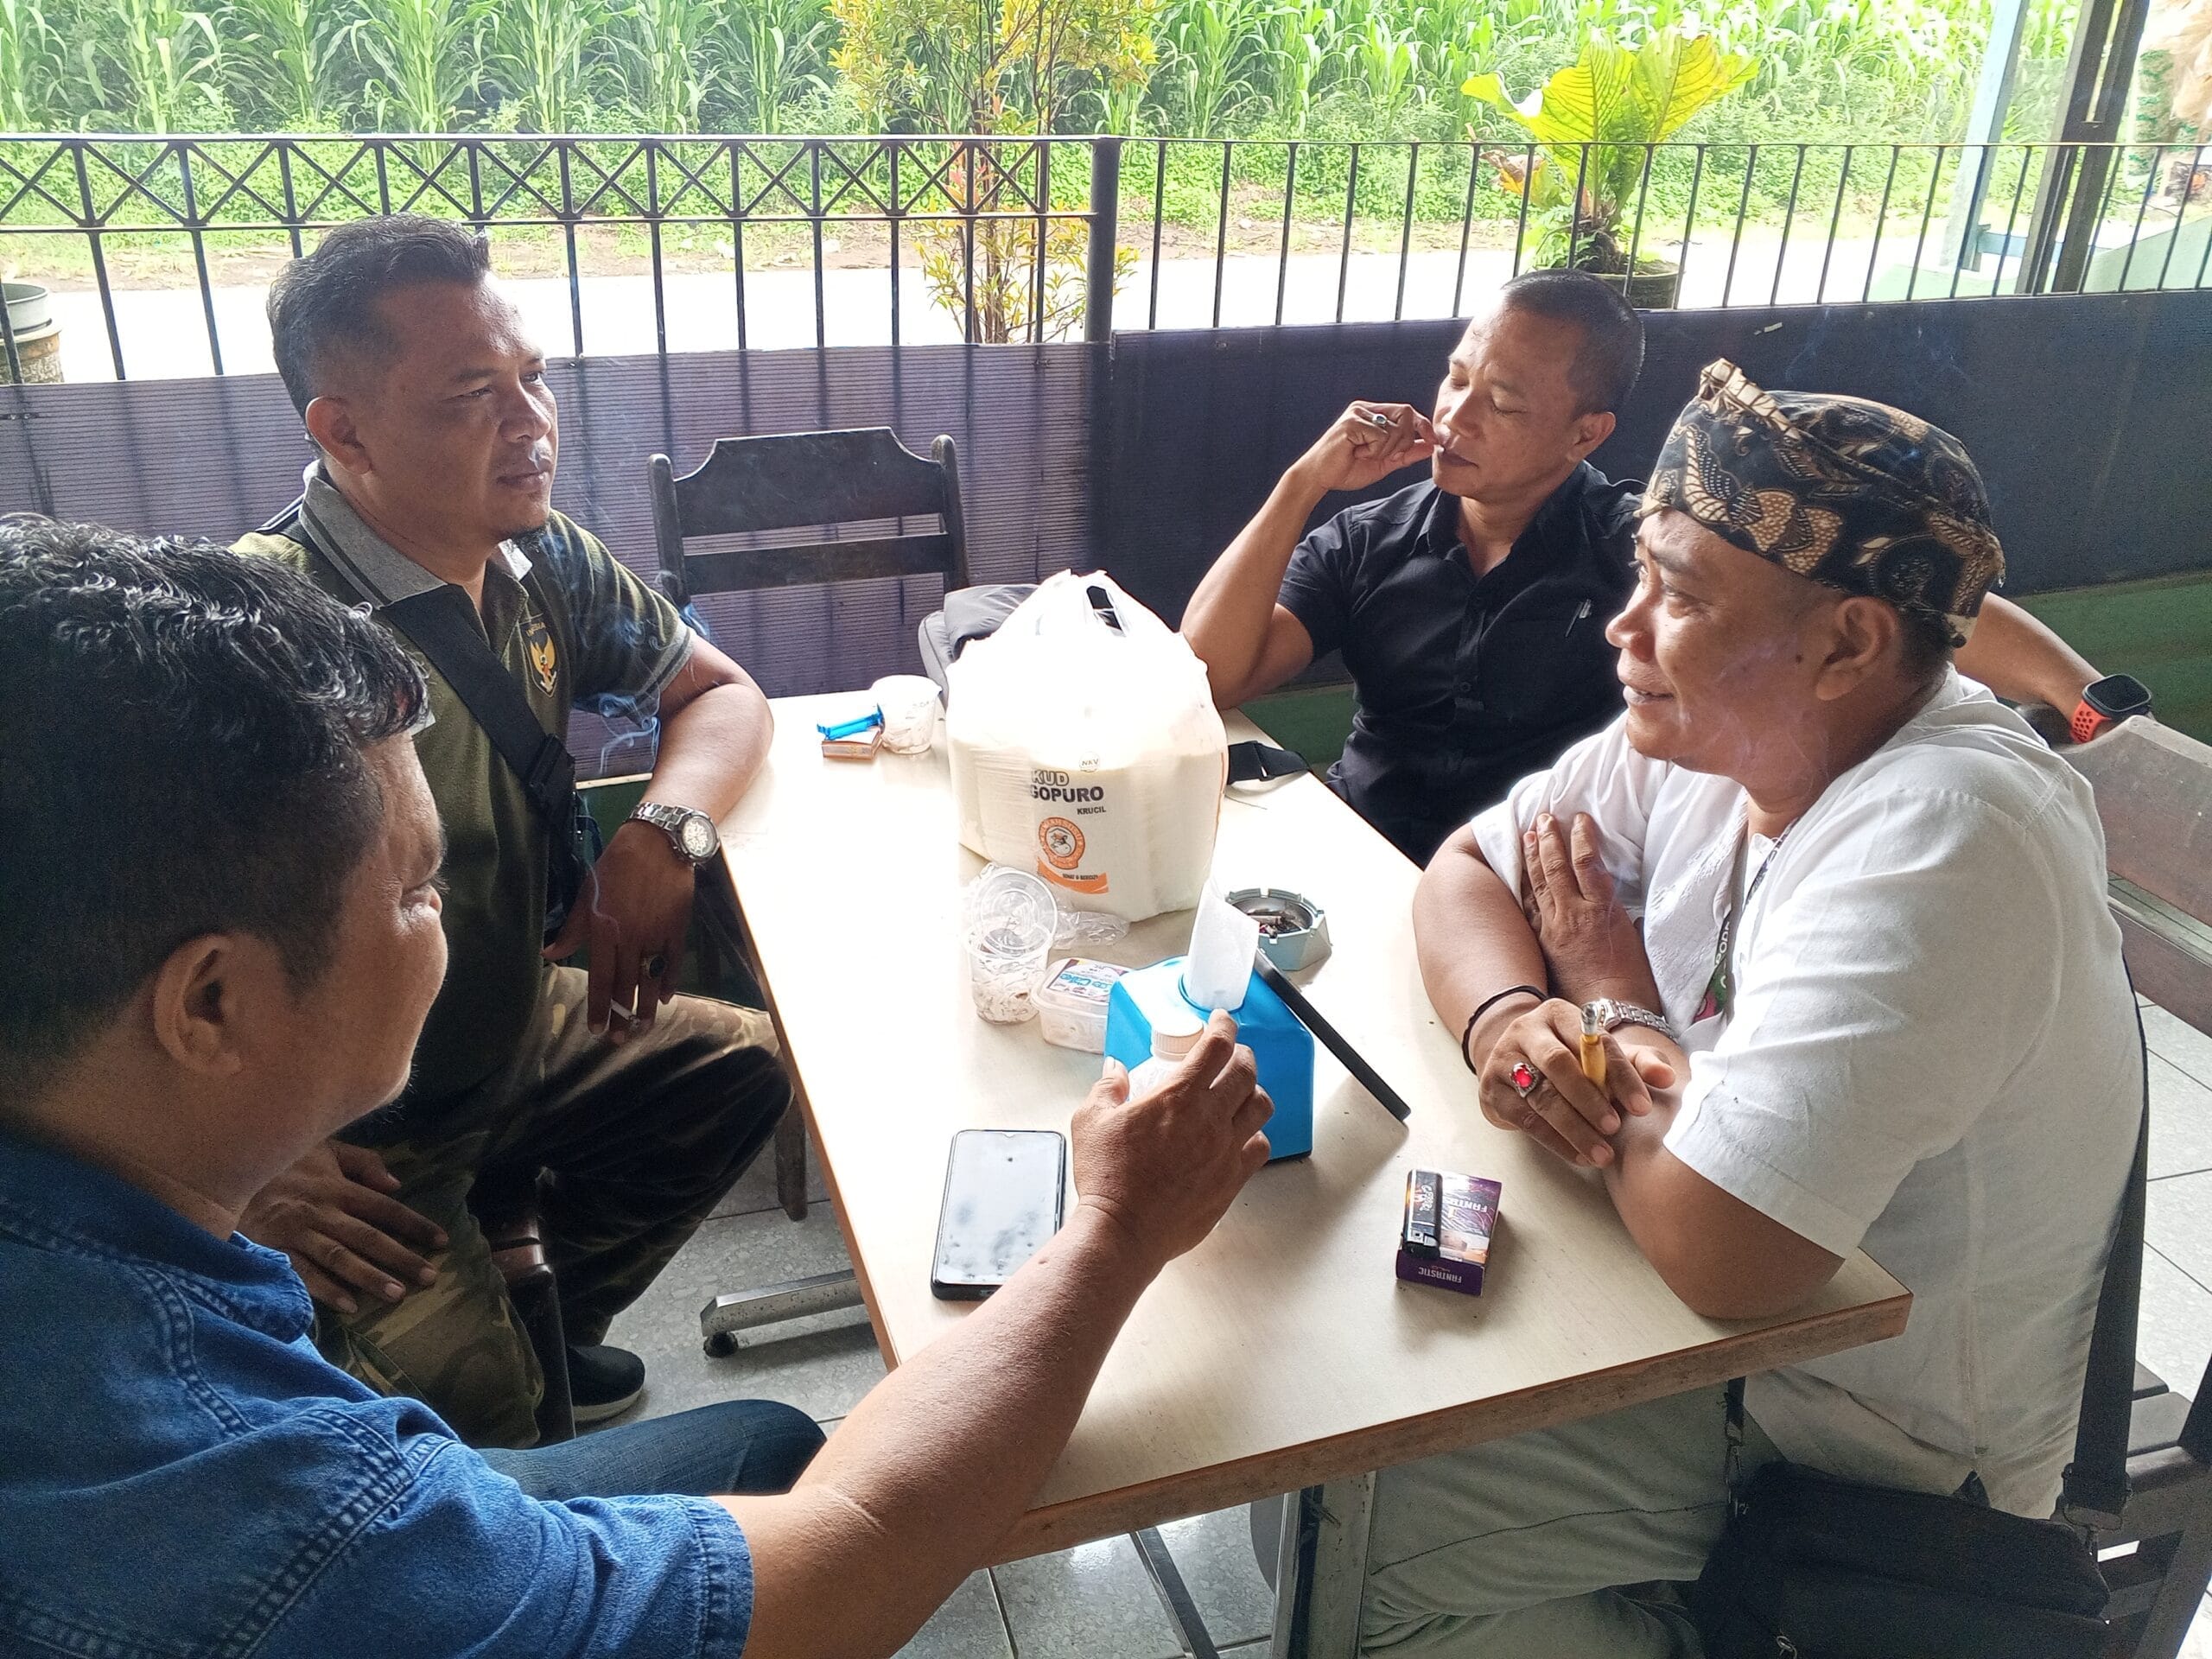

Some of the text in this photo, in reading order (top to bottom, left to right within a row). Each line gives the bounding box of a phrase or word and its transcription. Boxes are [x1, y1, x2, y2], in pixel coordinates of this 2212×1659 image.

[1031, 769, 1070, 787] KUD
[1077, 805, 1107, 816] KRUCIL
[1418, 1267, 1462, 1284] FANTASTIC
